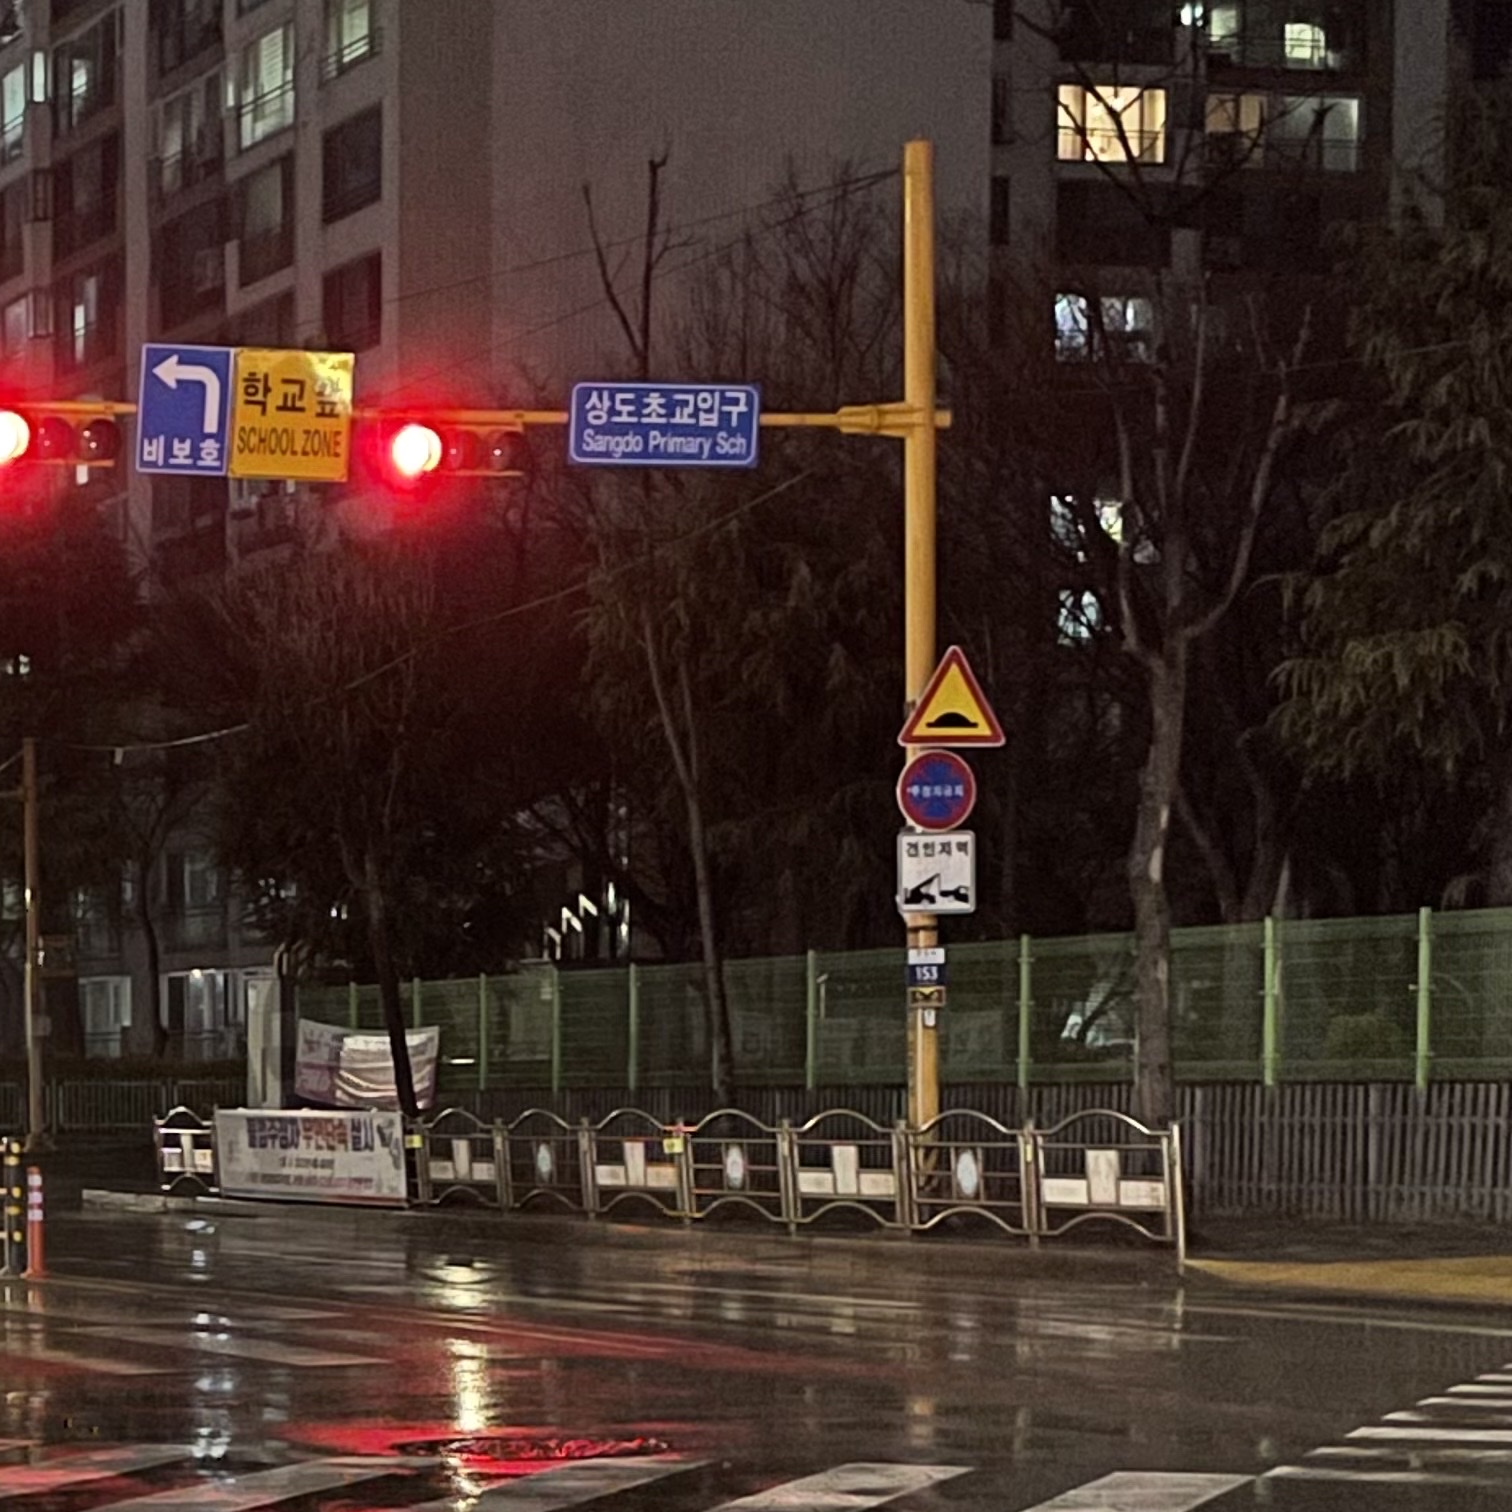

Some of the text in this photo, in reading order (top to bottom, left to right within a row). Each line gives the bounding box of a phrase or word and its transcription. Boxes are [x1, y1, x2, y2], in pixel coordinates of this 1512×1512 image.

[585, 390, 749, 427] 상도초교입구
[142, 434, 222, 467] 비보호
[237, 426, 343, 458] SCHOOL ZONE
[582, 428, 747, 460] Sangdo Primary Sch
